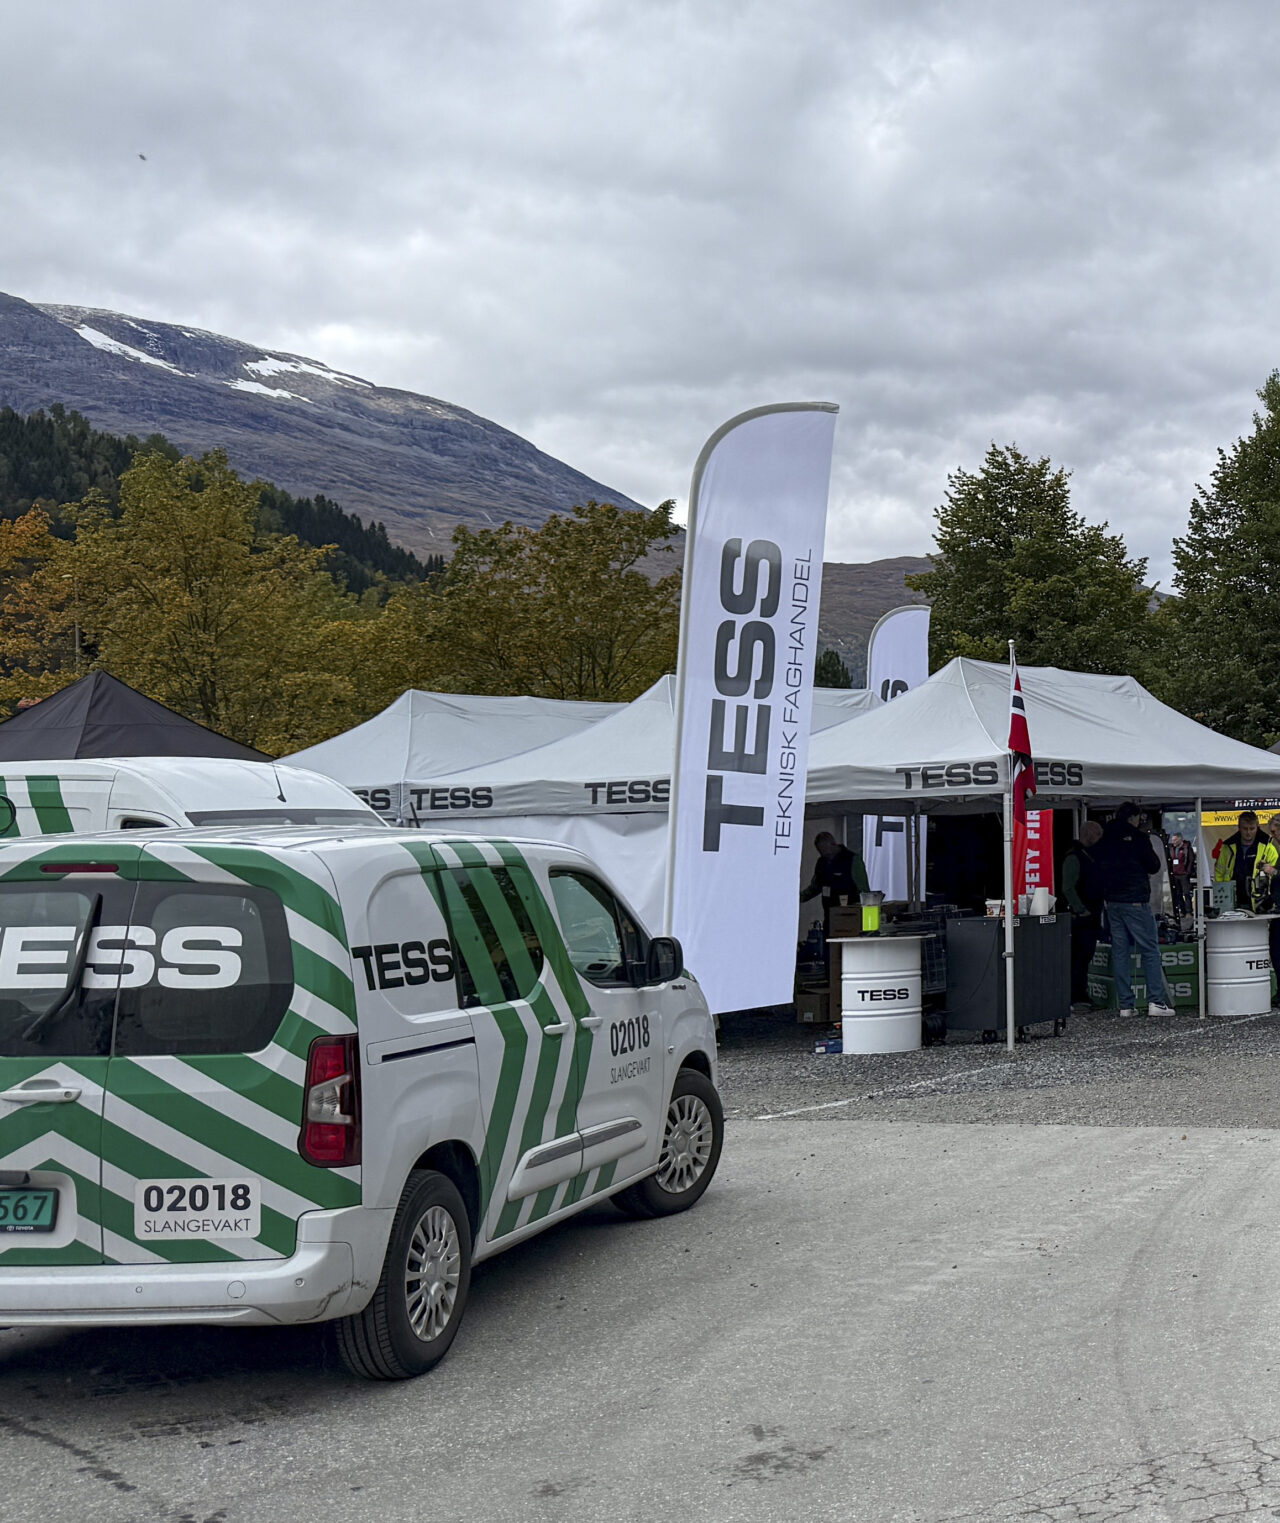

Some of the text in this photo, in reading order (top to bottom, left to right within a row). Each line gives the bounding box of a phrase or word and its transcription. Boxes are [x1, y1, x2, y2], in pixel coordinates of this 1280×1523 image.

[702, 537, 782, 852] TESS
[774, 548, 812, 855] TEKNISK FAGHANDEL
[896, 761, 999, 790] TESS
[1034, 762, 1083, 787] ESS
[410, 786, 494, 811] TESS
[584, 779, 671, 805] TESS
[1025, 810, 1041, 895] FIR FETY
[0, 926, 243, 990] ESS
[351, 938, 455, 991] TESS
[1246, 959, 1271, 970] TES
[857, 988, 909, 1001] TESS
[610, 1014, 650, 1056] 02018
[610, 1057, 651, 1085] SLANGEVAKT
[143, 1184, 251, 1212] 02018
[144, 1219, 251, 1233] SLANGEVAKT
